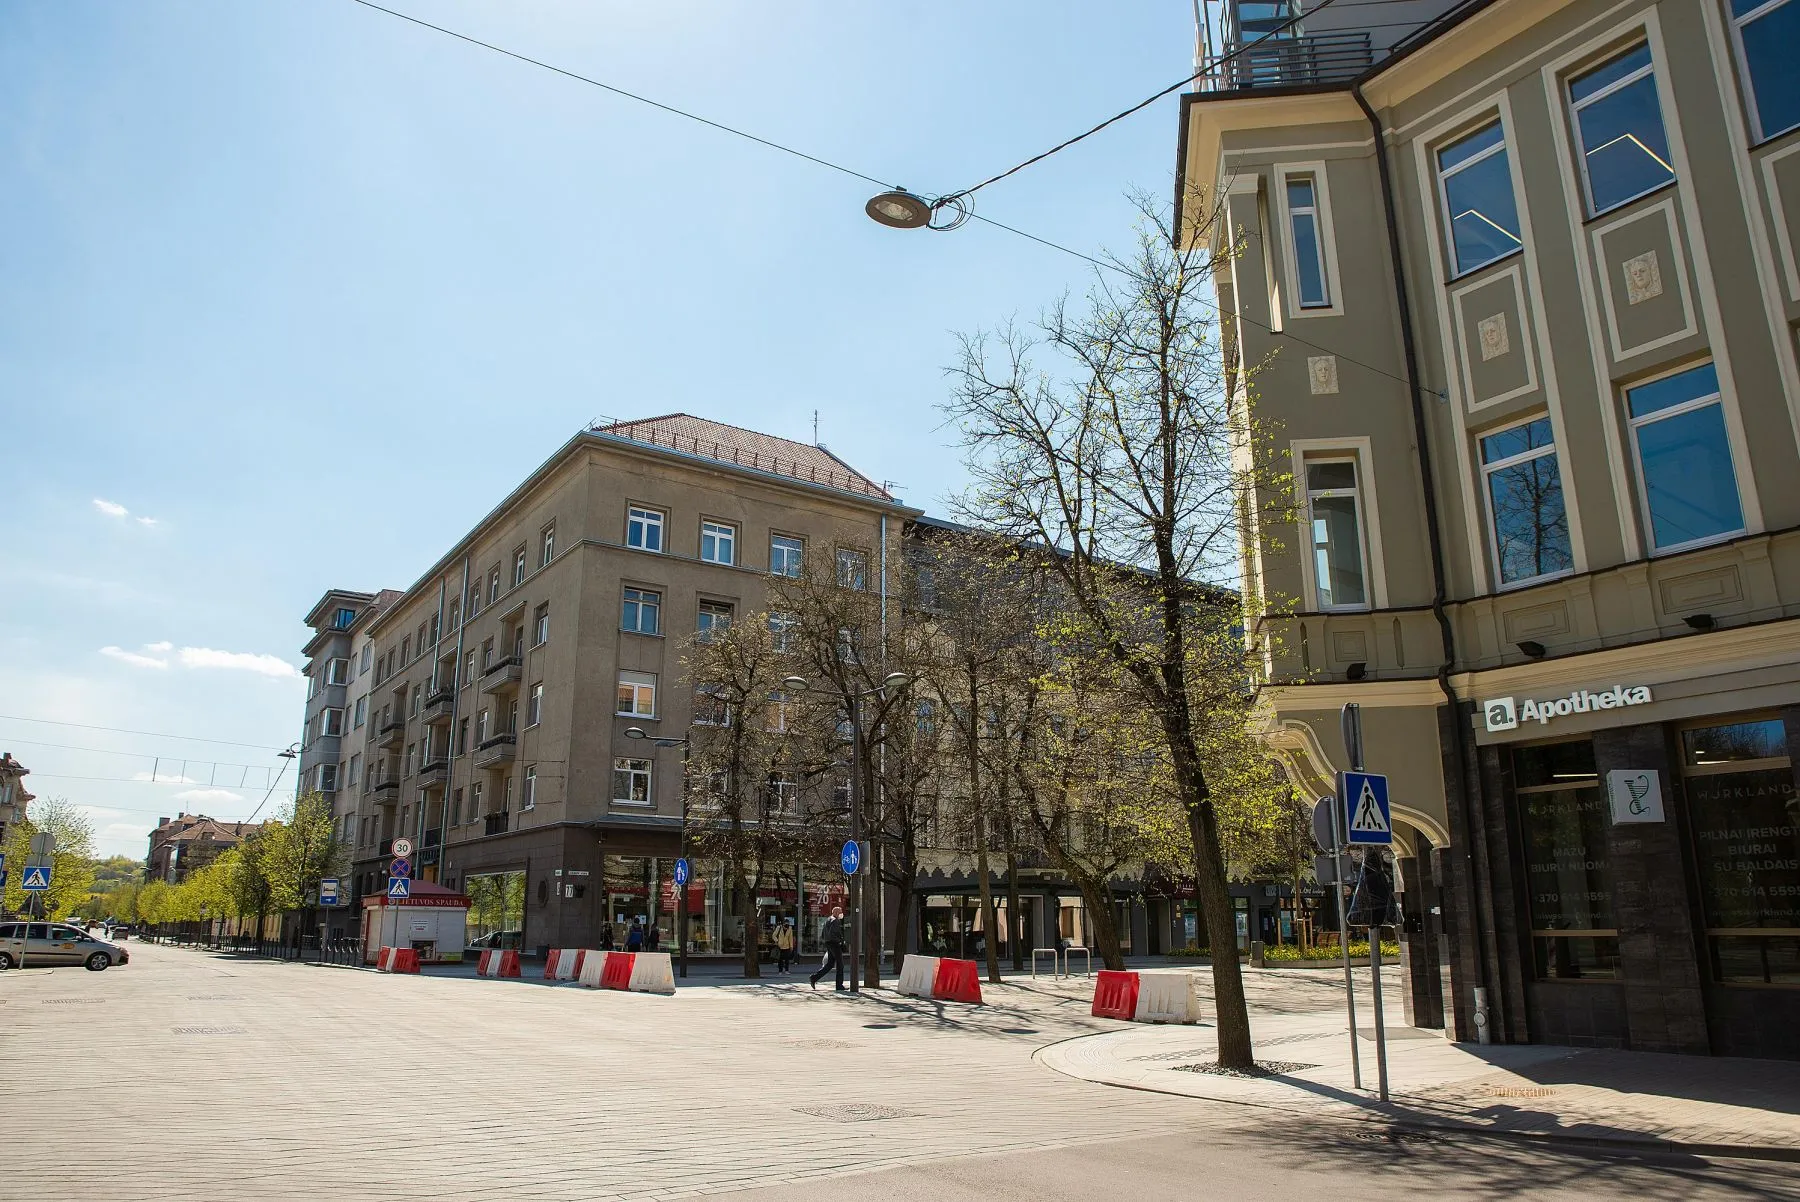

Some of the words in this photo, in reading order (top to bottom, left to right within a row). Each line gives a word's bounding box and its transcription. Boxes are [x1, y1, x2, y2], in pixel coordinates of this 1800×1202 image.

[1521, 685, 1652, 725] Apotheka
[397, 844, 408, 853] 30
[1728, 843, 1777, 856] BIURAI
[1713, 862, 1732, 873] SU
[1736, 860, 1799, 872] BALDAIS
[1742, 885, 1766, 897] 614
[435, 899, 464, 907] SPAUDA
